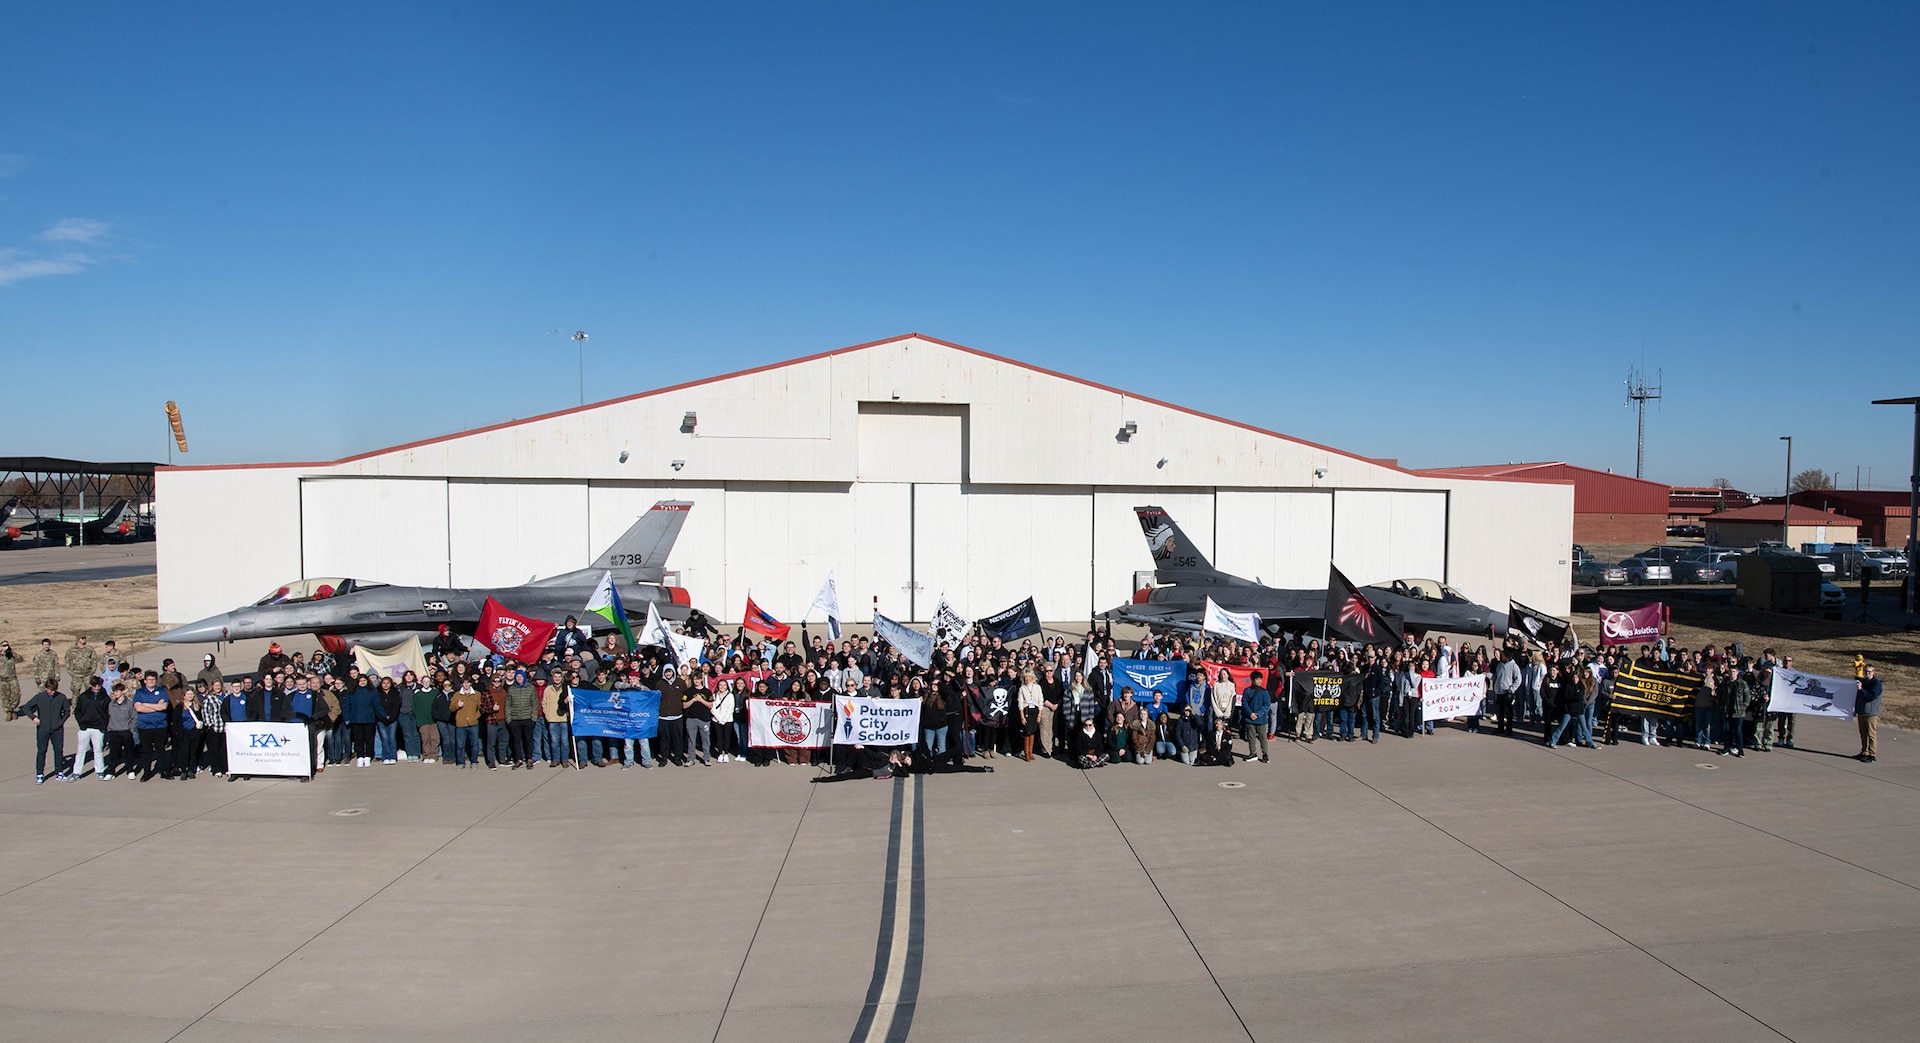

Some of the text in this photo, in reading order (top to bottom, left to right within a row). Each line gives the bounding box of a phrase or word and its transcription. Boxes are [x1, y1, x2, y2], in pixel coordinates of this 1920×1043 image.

[619, 554, 642, 566] 738
[1178, 556, 1197, 567] 545
[516, 622, 531, 636] LION
[1634, 625, 1658, 636] Aviation
[1312, 677, 1343, 685] TUPELO
[1424, 681, 1481, 693] EAST CENTRAL
[1637, 681, 1678, 694] MOSELEY
[1313, 698, 1340, 706] TIGERS
[1425, 695, 1474, 707] CARDINALS
[1643, 692, 1672, 703] TIGERS
[602, 709, 628, 718] CHRISTIAN
[859, 704, 913, 717] Putnam
[859, 717, 889, 731] City
[249, 733, 282, 748] KA
[858, 729, 911, 742] Schools
